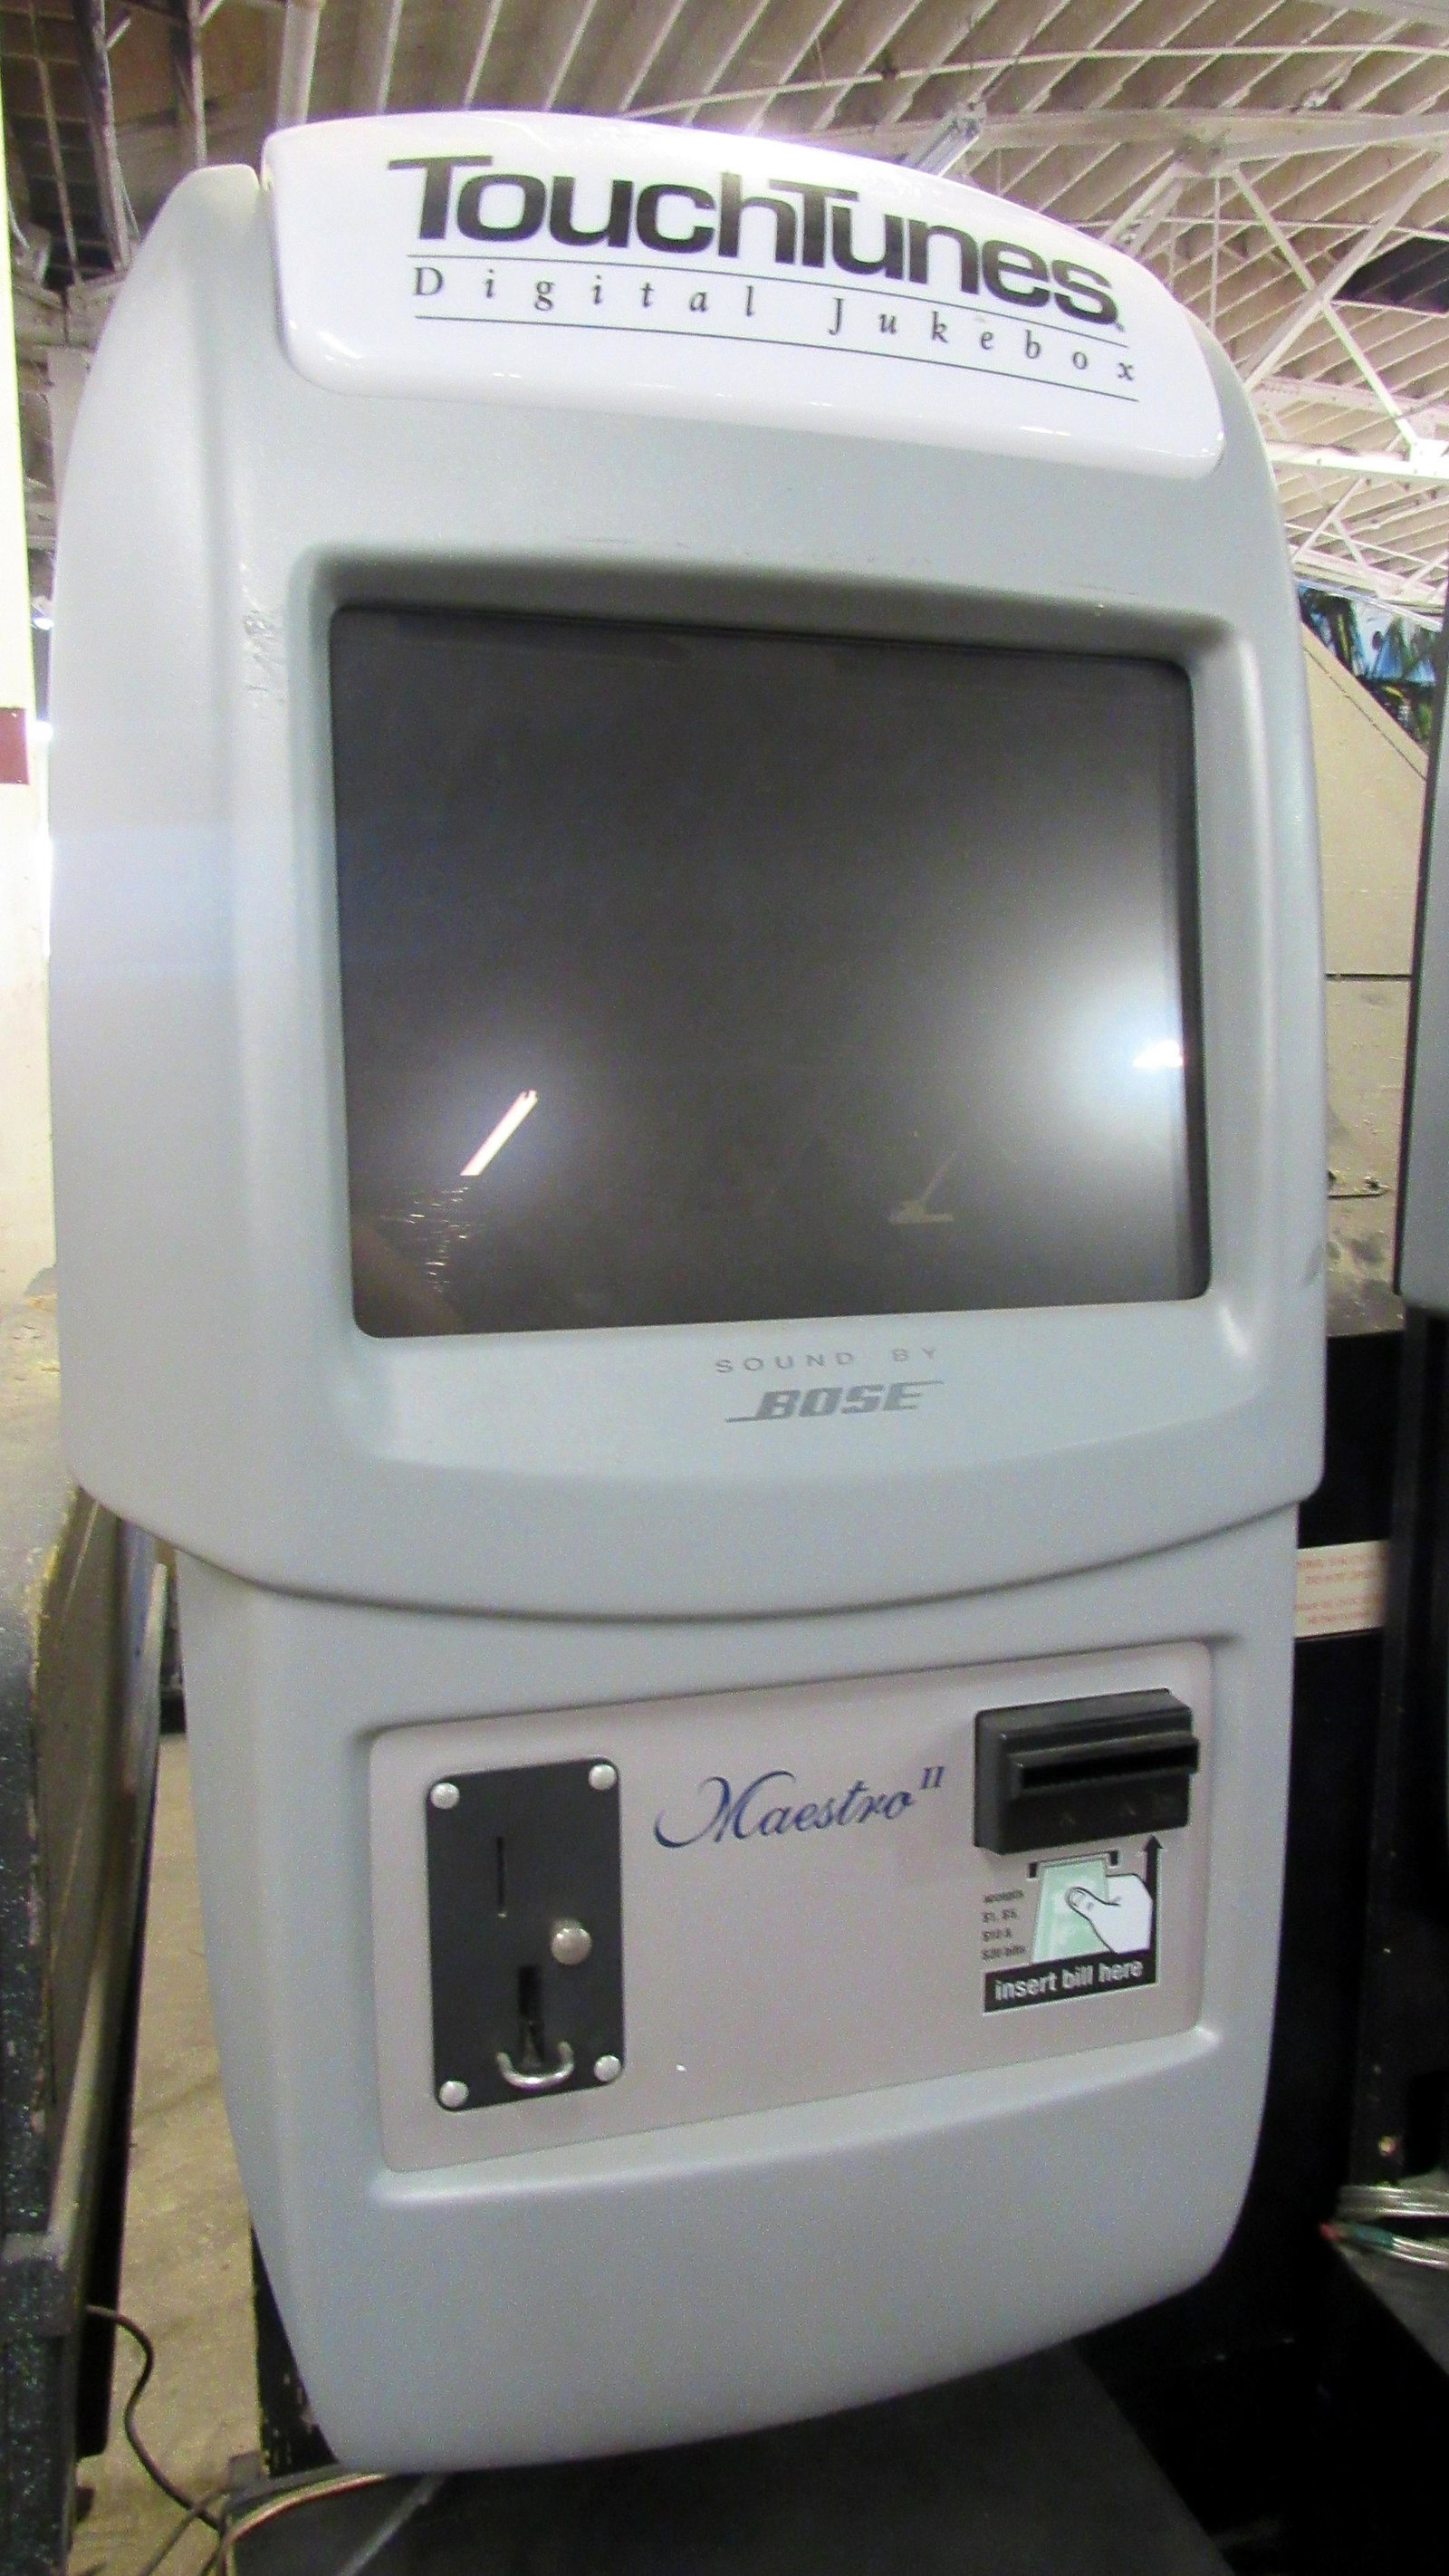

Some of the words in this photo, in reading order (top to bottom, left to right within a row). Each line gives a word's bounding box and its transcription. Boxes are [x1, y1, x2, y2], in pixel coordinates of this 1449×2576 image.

[388, 154, 1119, 326] TouchTunes
[412, 265, 754, 317] Digital
[829, 296, 1136, 381] Jukebox
[715, 1350, 855, 1374] SOUND
[891, 1346, 936, 1362] BY
[724, 1379, 945, 1424] BOSE
[654, 1770, 916, 1849] Maestro
[918, 1765, 945, 1790] II
[994, 1971, 1058, 2001] insert
[1061, 1965, 1094, 1990] bill
[1099, 1960, 1144, 1983] here
